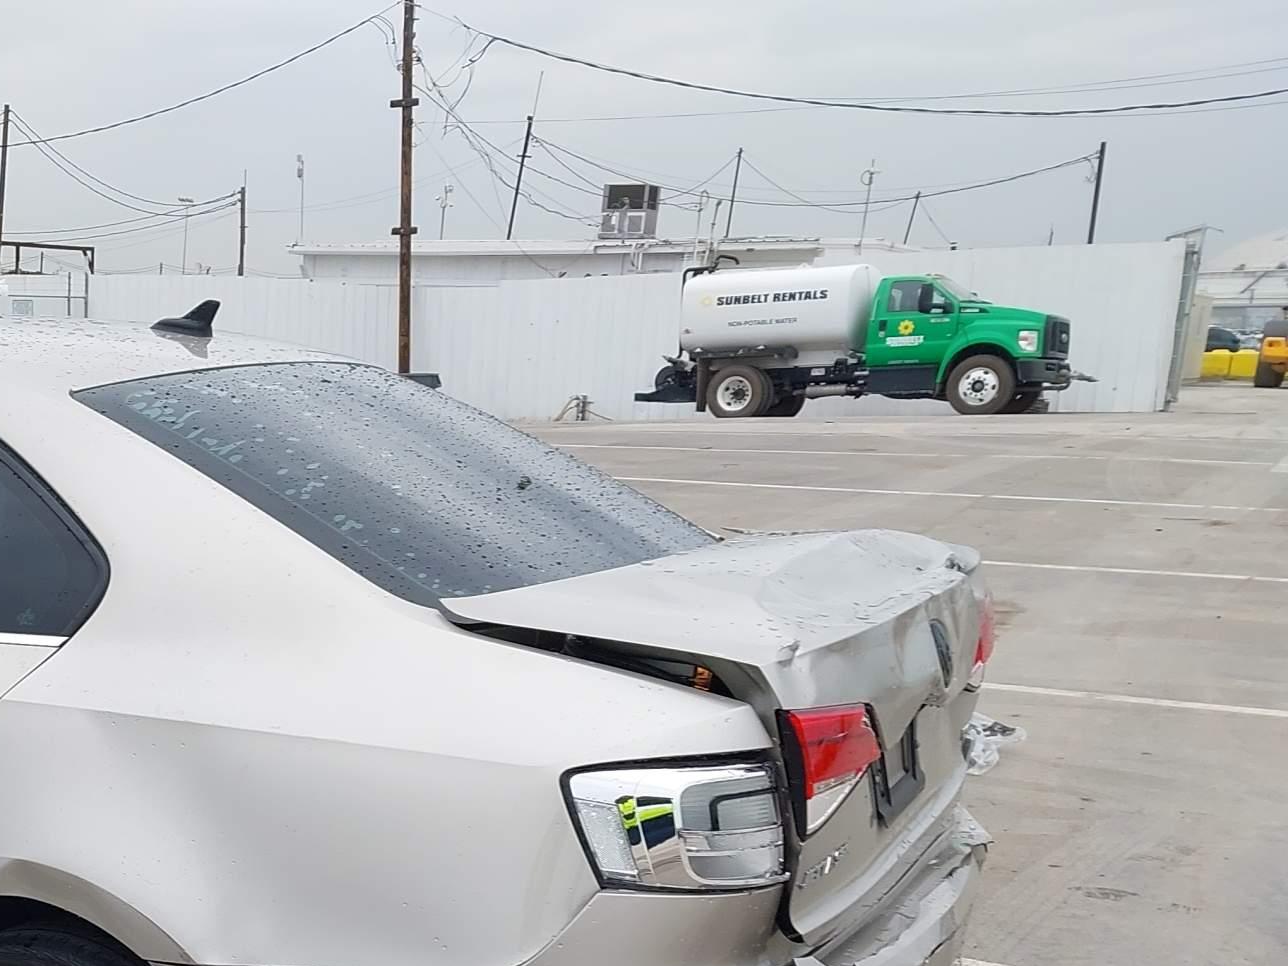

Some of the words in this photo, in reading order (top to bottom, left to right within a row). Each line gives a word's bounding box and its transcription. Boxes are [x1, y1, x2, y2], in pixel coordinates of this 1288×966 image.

[716, 293, 769, 306] SUNBELT
[773, 289, 829, 303] RENTALS
[727, 318, 773, 328] NON-POTABLE
[775, 317, 798, 325] WATER
